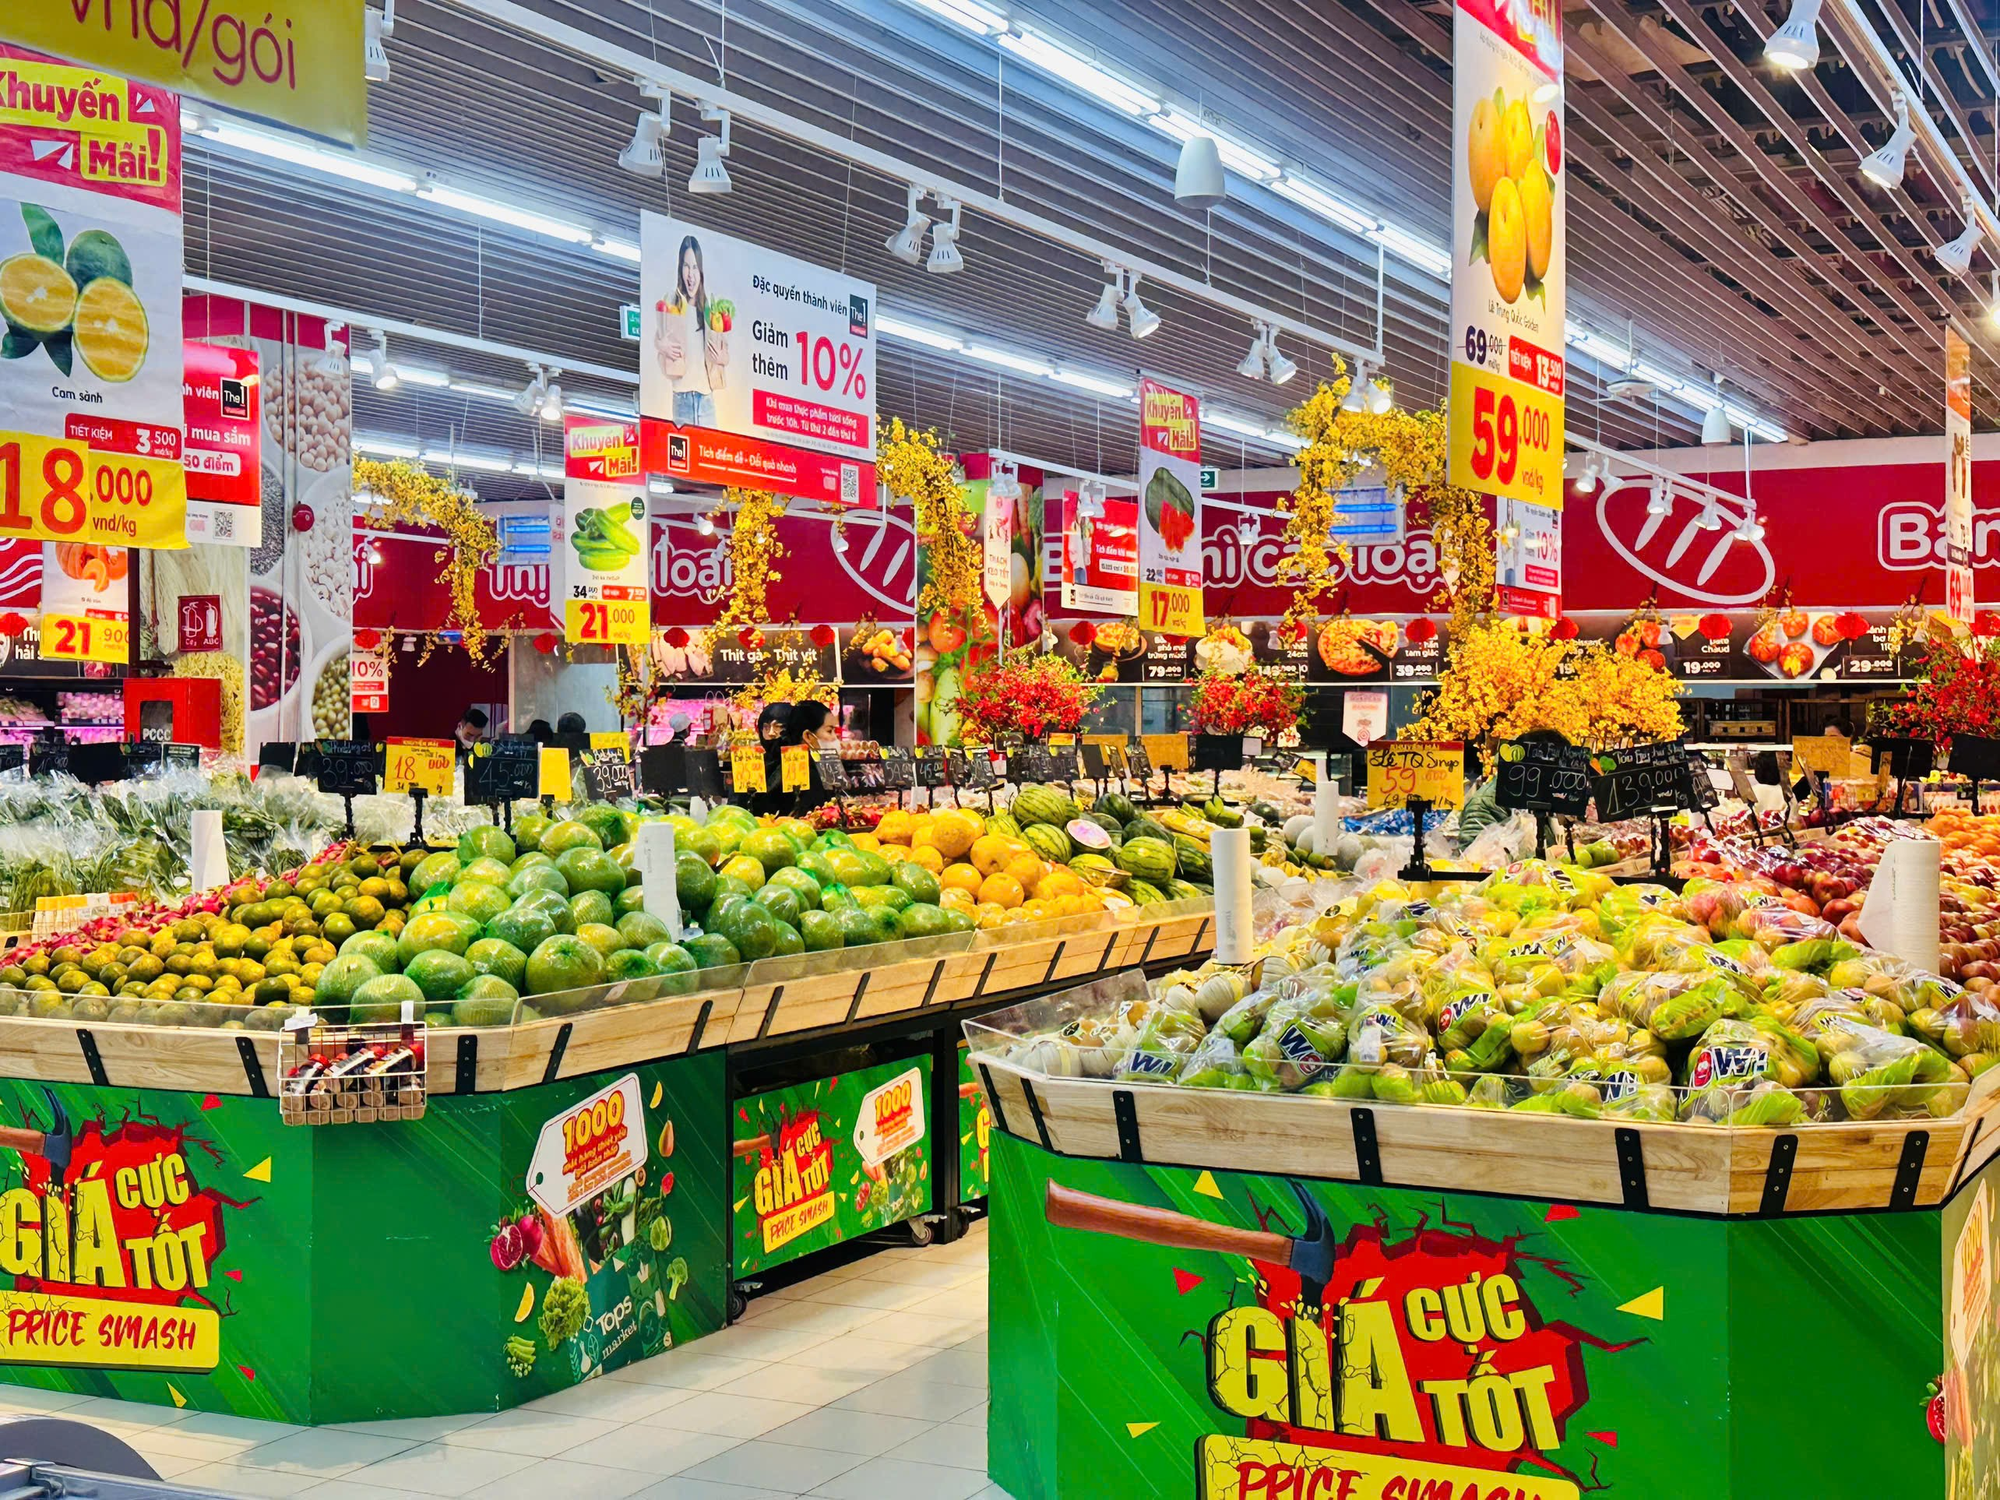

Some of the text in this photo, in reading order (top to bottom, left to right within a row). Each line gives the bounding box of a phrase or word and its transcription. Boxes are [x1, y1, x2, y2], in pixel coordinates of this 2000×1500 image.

[88, 128, 161, 182] Mãi!
[752, 275, 771, 294] Đặc
[803, 290, 828, 310] thành
[830, 297, 848, 316] viên
[752, 320, 789, 349] Giảm
[752, 353, 789, 381] thêm
[796, 330, 867, 400] 10%
[52, 386, 103, 404] Cam sành
[70, 422, 90, 437] TIẾT
[91, 426, 113, 442] KIỆM
[191, 425, 251, 446] mua sắm
[92, 515, 137, 537] vnd/kg
[15, 643, 35, 660] hải
[720, 648, 744, 665] Thịt
[1701, 645, 1730, 653] Chaud
[142, 728, 172, 741] PCCC
[562, 1090, 625, 1155] 1000
[114, 1152, 190, 1217] CỰC
[754, 1139, 803, 1216] GIÁ
[0, 1160, 127, 1288] GIÁ
[798, 1199, 829, 1227] SMASH
[124, 1212, 208, 1291] TỐT
[7, 1308, 197, 1351] PRICE SMASH
[595, 1295, 633, 1336] Tops
[1404, 1270, 1526, 1355] CỰC
[602, 1318, 638, 1361] market
[1210, 1277, 1425, 1443] GIÁ
[1419, 1350, 1562, 1452] TỐT
